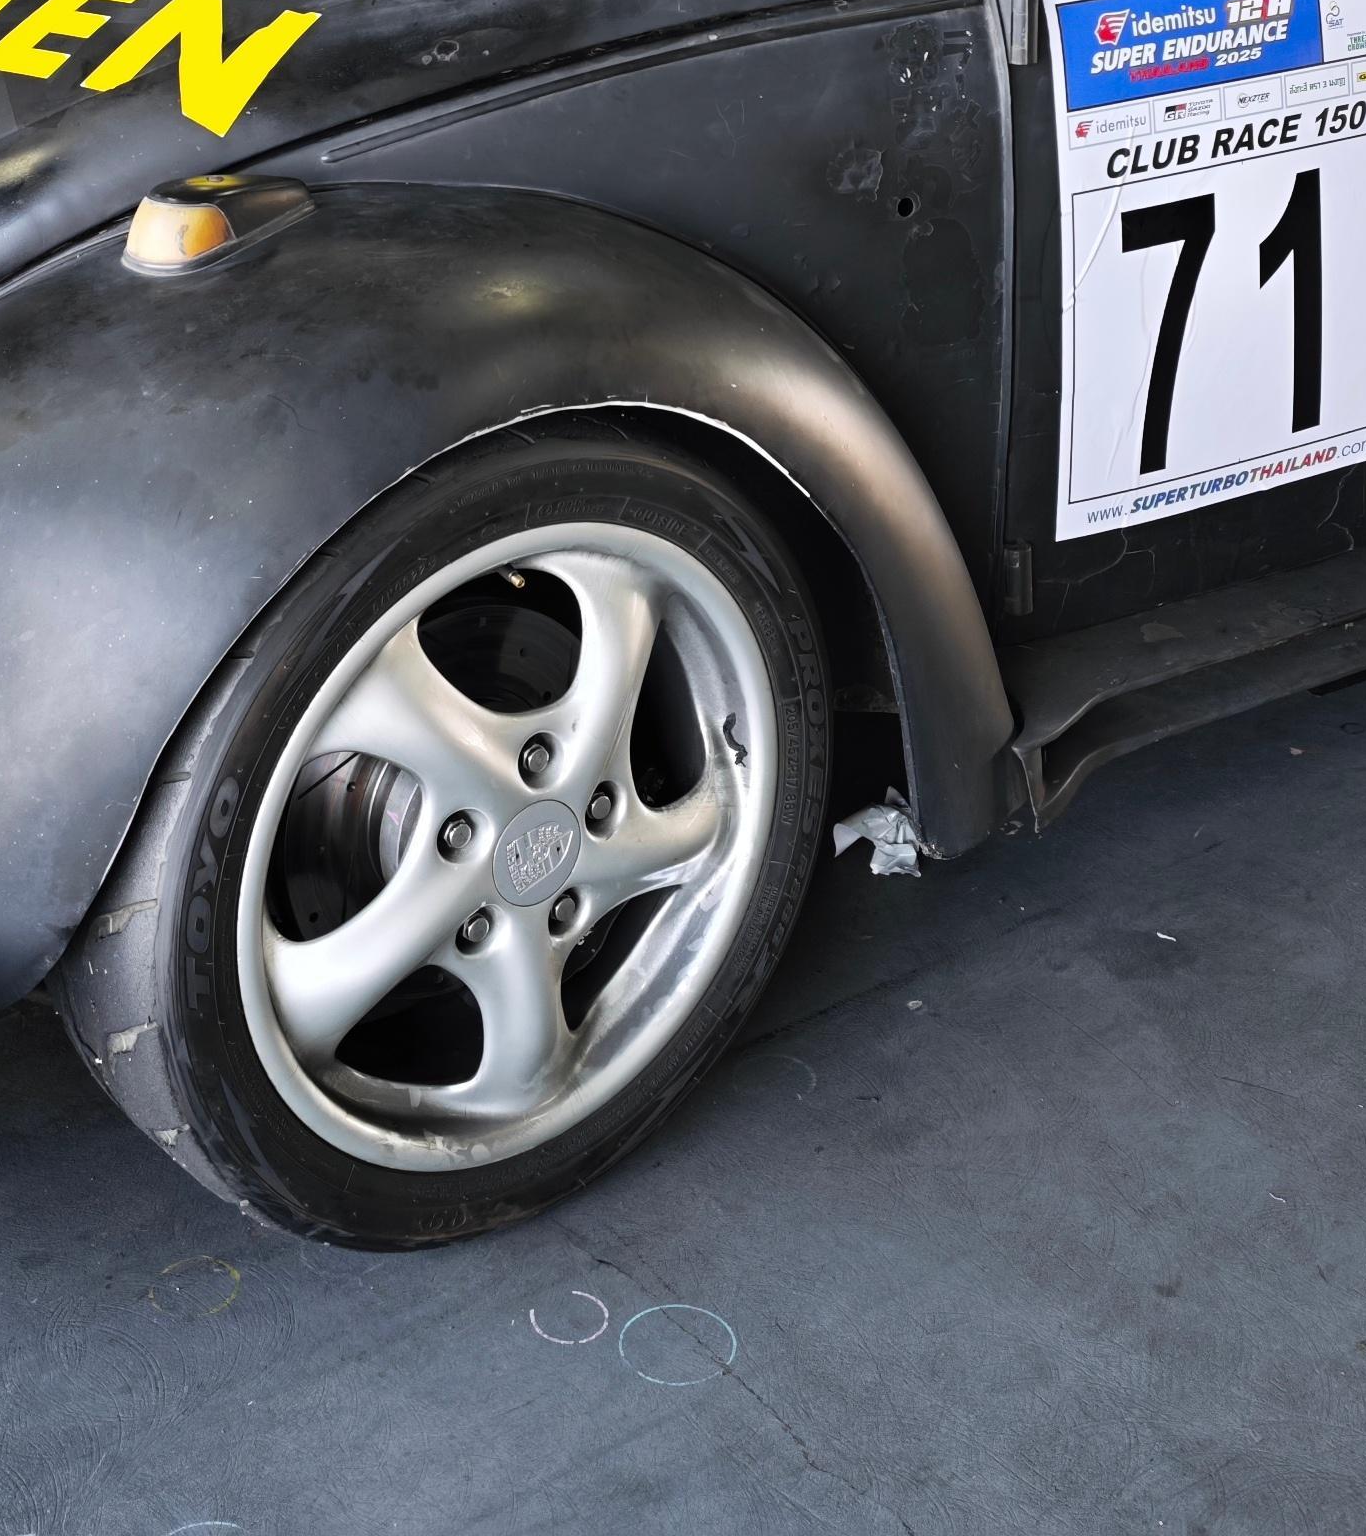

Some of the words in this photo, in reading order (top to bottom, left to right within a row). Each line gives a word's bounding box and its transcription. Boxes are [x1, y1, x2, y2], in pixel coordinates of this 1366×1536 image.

[1091, 42, 1156, 74] SUPER
[1163, 19, 1289, 61] ENDURANCE
[1131, 5, 1216, 36] idemitsu
[1215, 47, 1262, 67] 2025
[1096, 114, 1147, 134] idemitsu
[1107, 139, 1200, 180] CLUB
[1211, 116, 1300, 157] RACE
[1121, 168, 1323, 475] 71
[787, 619, 826, 836] PROXES
[186, 775, 241, 1010] TOYO
